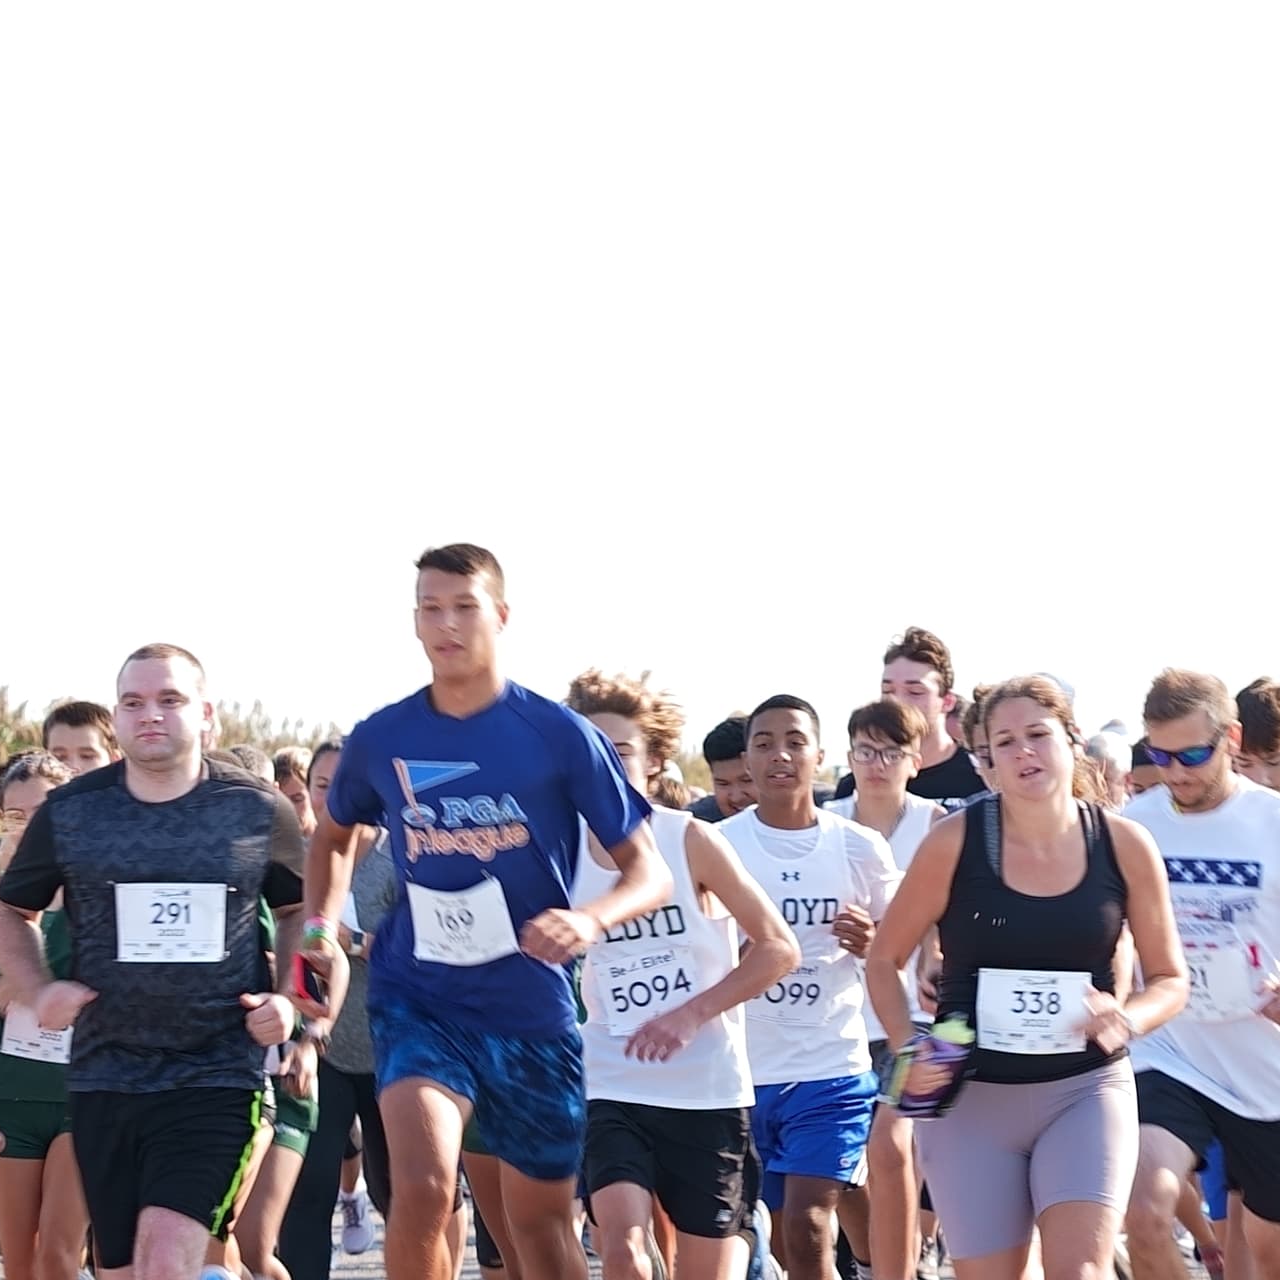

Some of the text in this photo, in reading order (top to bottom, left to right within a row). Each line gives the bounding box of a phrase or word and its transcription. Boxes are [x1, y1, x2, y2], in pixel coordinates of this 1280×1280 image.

[439, 793, 528, 828] PGA
[149, 902, 191, 924] 291
[602, 904, 686, 943] LOYD
[782, 898, 839, 925] OYD
[611, 968, 692, 1013] 5094
[755, 982, 821, 1006] 099
[1011, 990, 1061, 1015] 338
